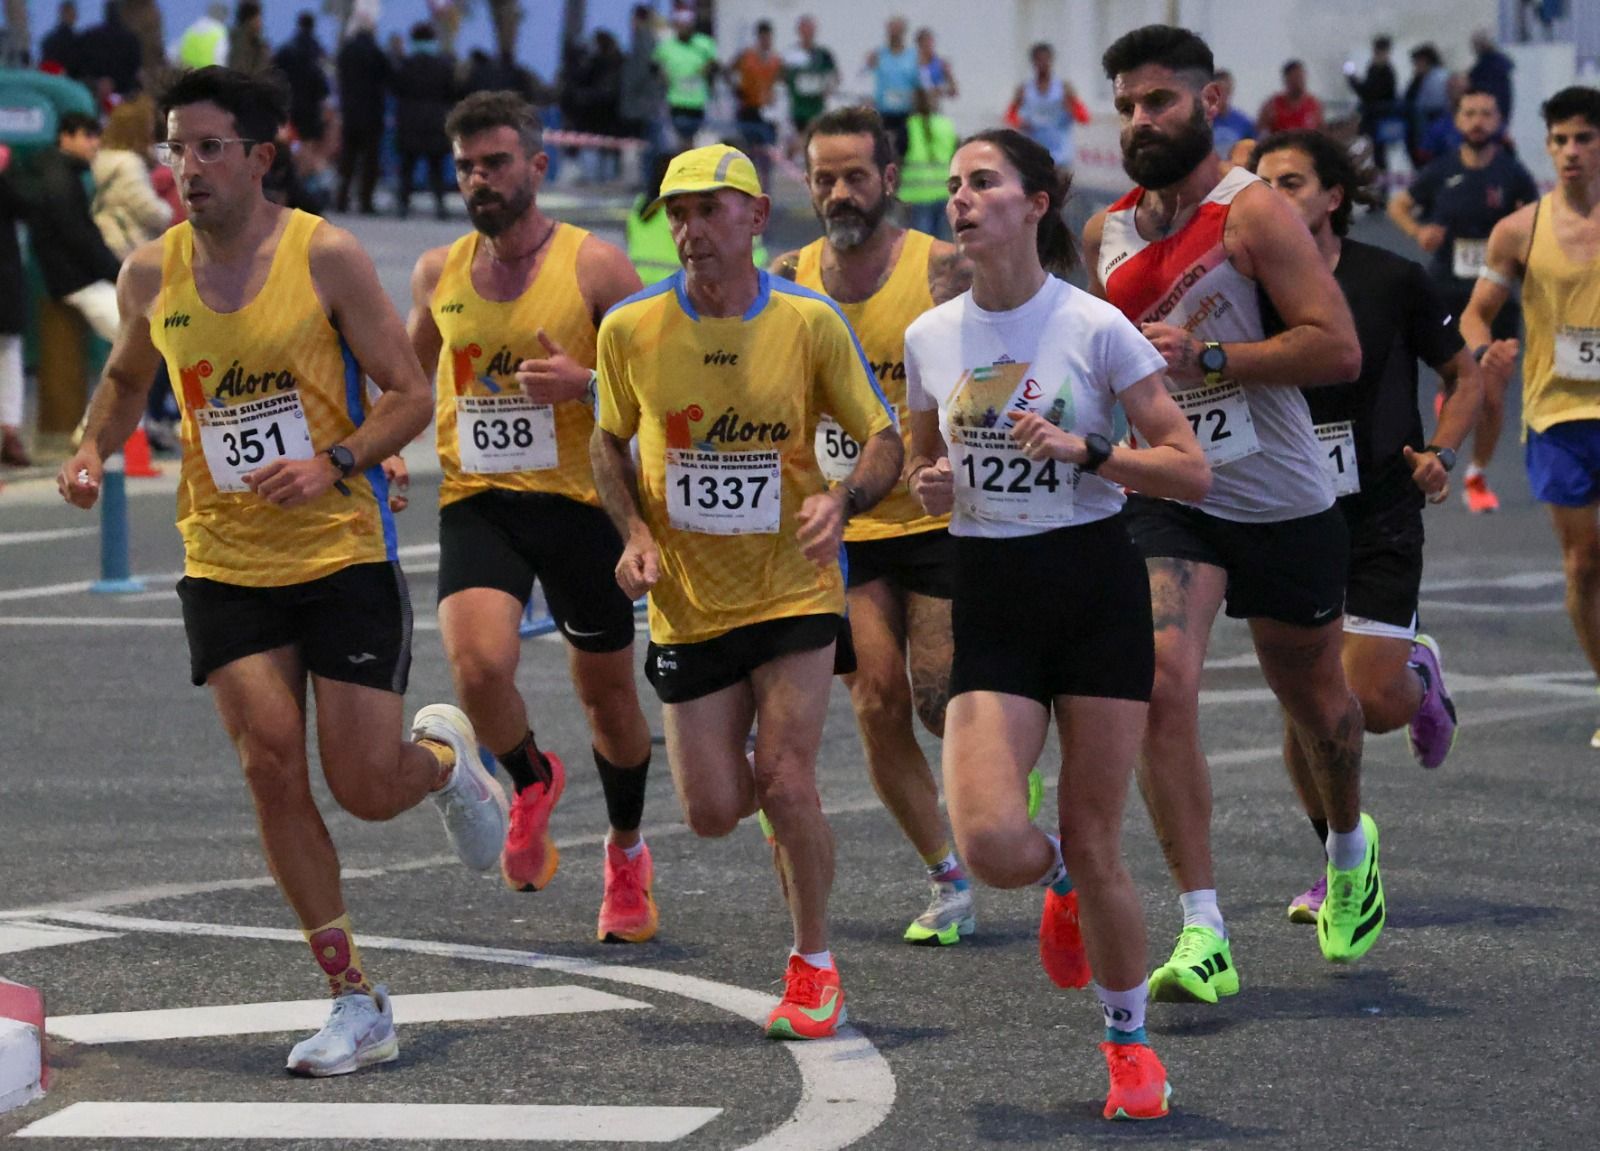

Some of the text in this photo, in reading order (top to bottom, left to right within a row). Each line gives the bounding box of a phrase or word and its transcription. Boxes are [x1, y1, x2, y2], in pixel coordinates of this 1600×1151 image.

[215, 360, 297, 398] Álora
[240, 393, 298, 414] SILVESTRE
[473, 418, 533, 450] 638
[705, 406, 790, 444] Álora
[962, 430, 977, 439] VII
[981, 431, 1006, 441] SAN
[223, 422, 286, 466] 351
[679, 452, 778, 463] VII SAN SILVESTRE
[962, 454, 1060, 493] 1224
[677, 474, 769, 510] 1337
